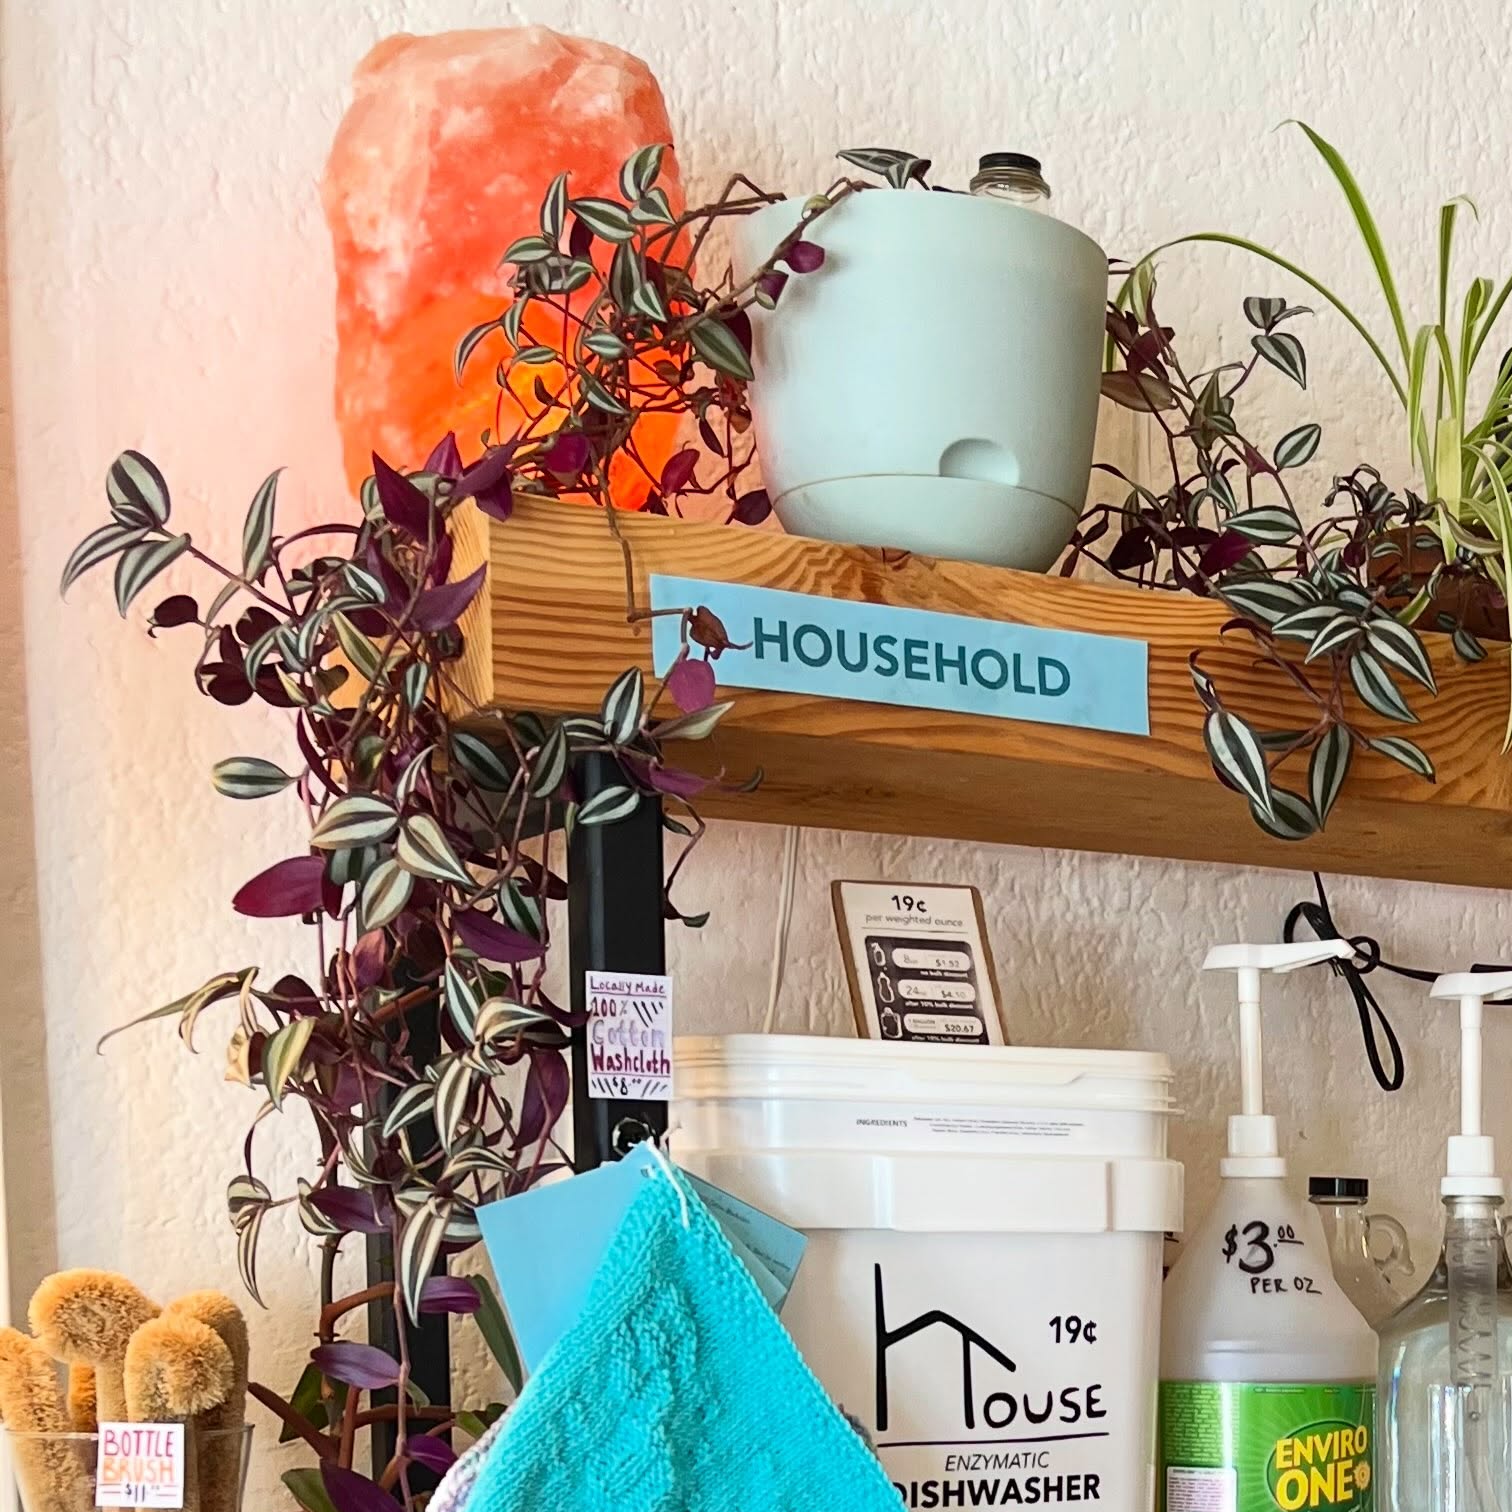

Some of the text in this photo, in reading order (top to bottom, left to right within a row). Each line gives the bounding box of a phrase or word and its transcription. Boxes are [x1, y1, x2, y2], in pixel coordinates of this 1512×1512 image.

[753, 616, 1071, 697] HOUSEHOLD
[865, 914, 882, 923] per
[590, 976, 665, 994] Locally Made
[592, 1019, 665, 1048] Cotton
[590, 1043, 671, 1074] Washcloth
[1251, 1276, 1322, 1295] PER OZ
[1048, 1315, 1097, 1344] 19¢
[104, 1429, 175, 1457] BOTTLE
[1276, 1425, 1367, 1469] ENVIRO
[103, 1457, 175, 1483] BRUSH
[944, 1451, 1050, 1472] ENZYMATIC
[1276, 1459, 1353, 1511] ONE
